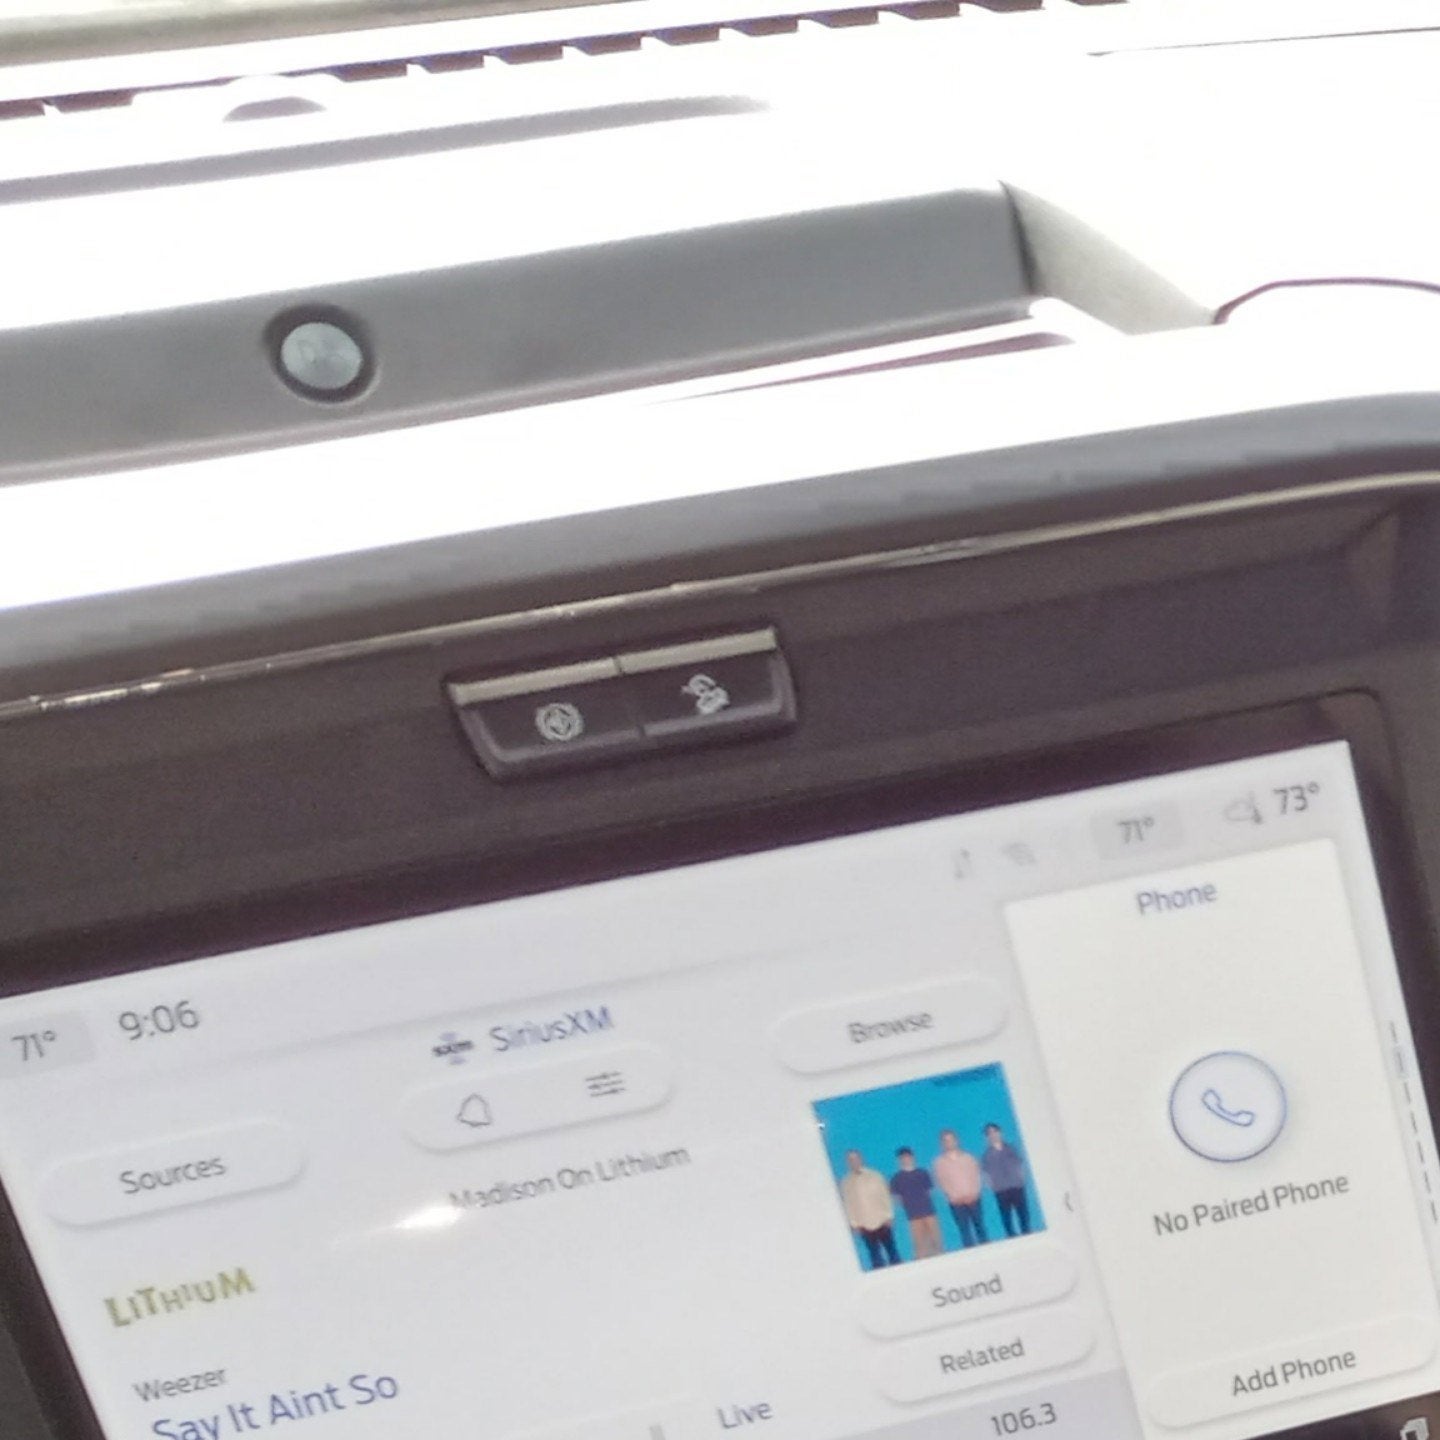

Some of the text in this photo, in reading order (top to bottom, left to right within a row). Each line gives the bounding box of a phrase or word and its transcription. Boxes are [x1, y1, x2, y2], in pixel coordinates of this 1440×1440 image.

[1273, 782, 1320, 816] 73°
[1135, 880, 1217, 916] Phone
[119, 1000, 199, 1040] 9:06
[489, 1006, 614, 1052] SiriusXM
[848, 1007, 933, 1046] Browse
[119, 1153, 227, 1197] Sources
[450, 1147, 692, 1207] Madison On Lithium
[1152, 1171, 1350, 1238] No Paired Phone
[931, 1273, 1004, 1309] Sound
[938, 1336, 1025, 1376] Related
[1231, 1347, 1357, 1398] Add Phone
[132, 1366, 228, 1403] Weezer
[227, 1402, 259, 1433] It
[269, 1383, 341, 1425] Aint
[347, 1372, 399, 1404] So
[716, 1399, 773, 1430] Live
[987, 1402, 1058, 1437] 106.3
